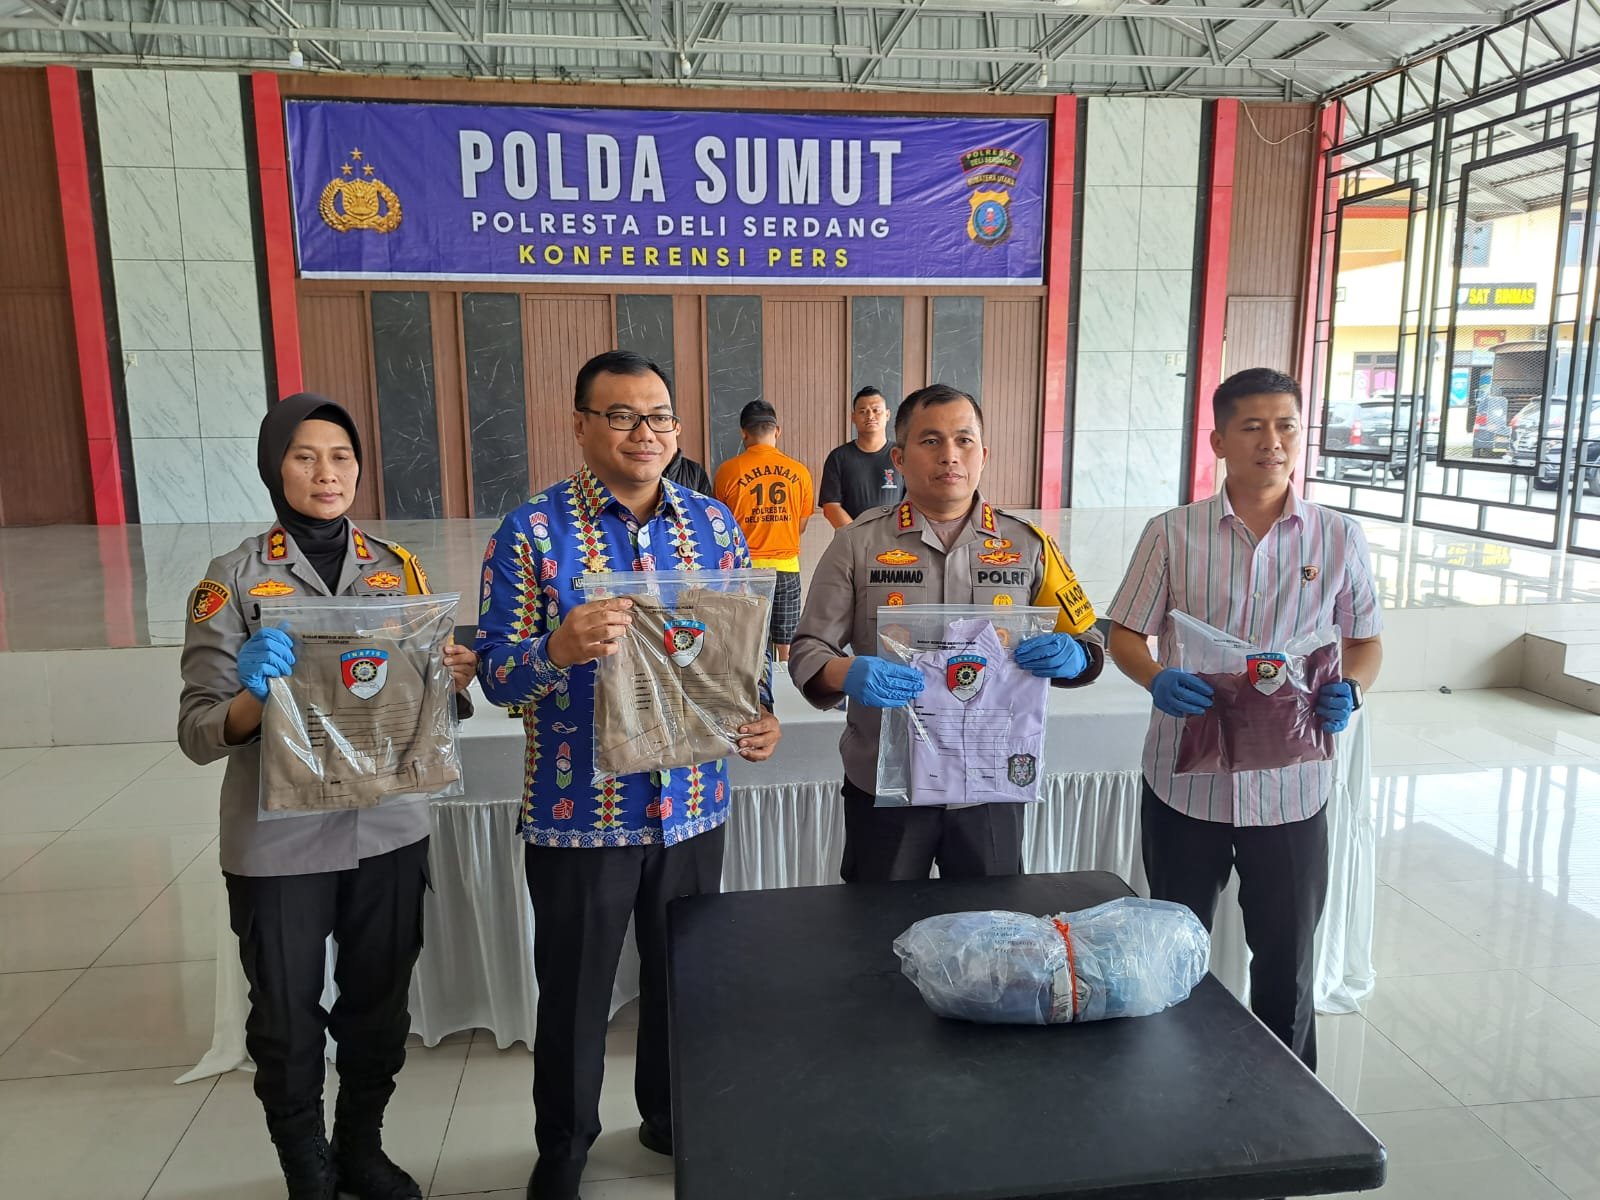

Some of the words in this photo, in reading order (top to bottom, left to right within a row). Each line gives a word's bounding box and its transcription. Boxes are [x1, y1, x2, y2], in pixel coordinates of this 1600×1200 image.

[459, 129, 666, 203] POLDA
[694, 135, 902, 206] SUMUT
[471, 210, 640, 236] POLRESTA
[657, 214, 726, 237] DELI
[743, 216, 890, 239] SERDANG
[519, 244, 745, 267] KONFERENSI
[768, 247, 848, 268] PERS
[1469, 287, 1491, 305] SAT
[737, 464, 800, 488] TAHANAN
[750, 481, 787, 506] 16
[751, 506, 788, 516] POLRESTA
[869, 570, 924, 584] MUHAMMAD
[977, 571, 1025, 585] POLRI
[347, 650, 382, 659] INAFIS
